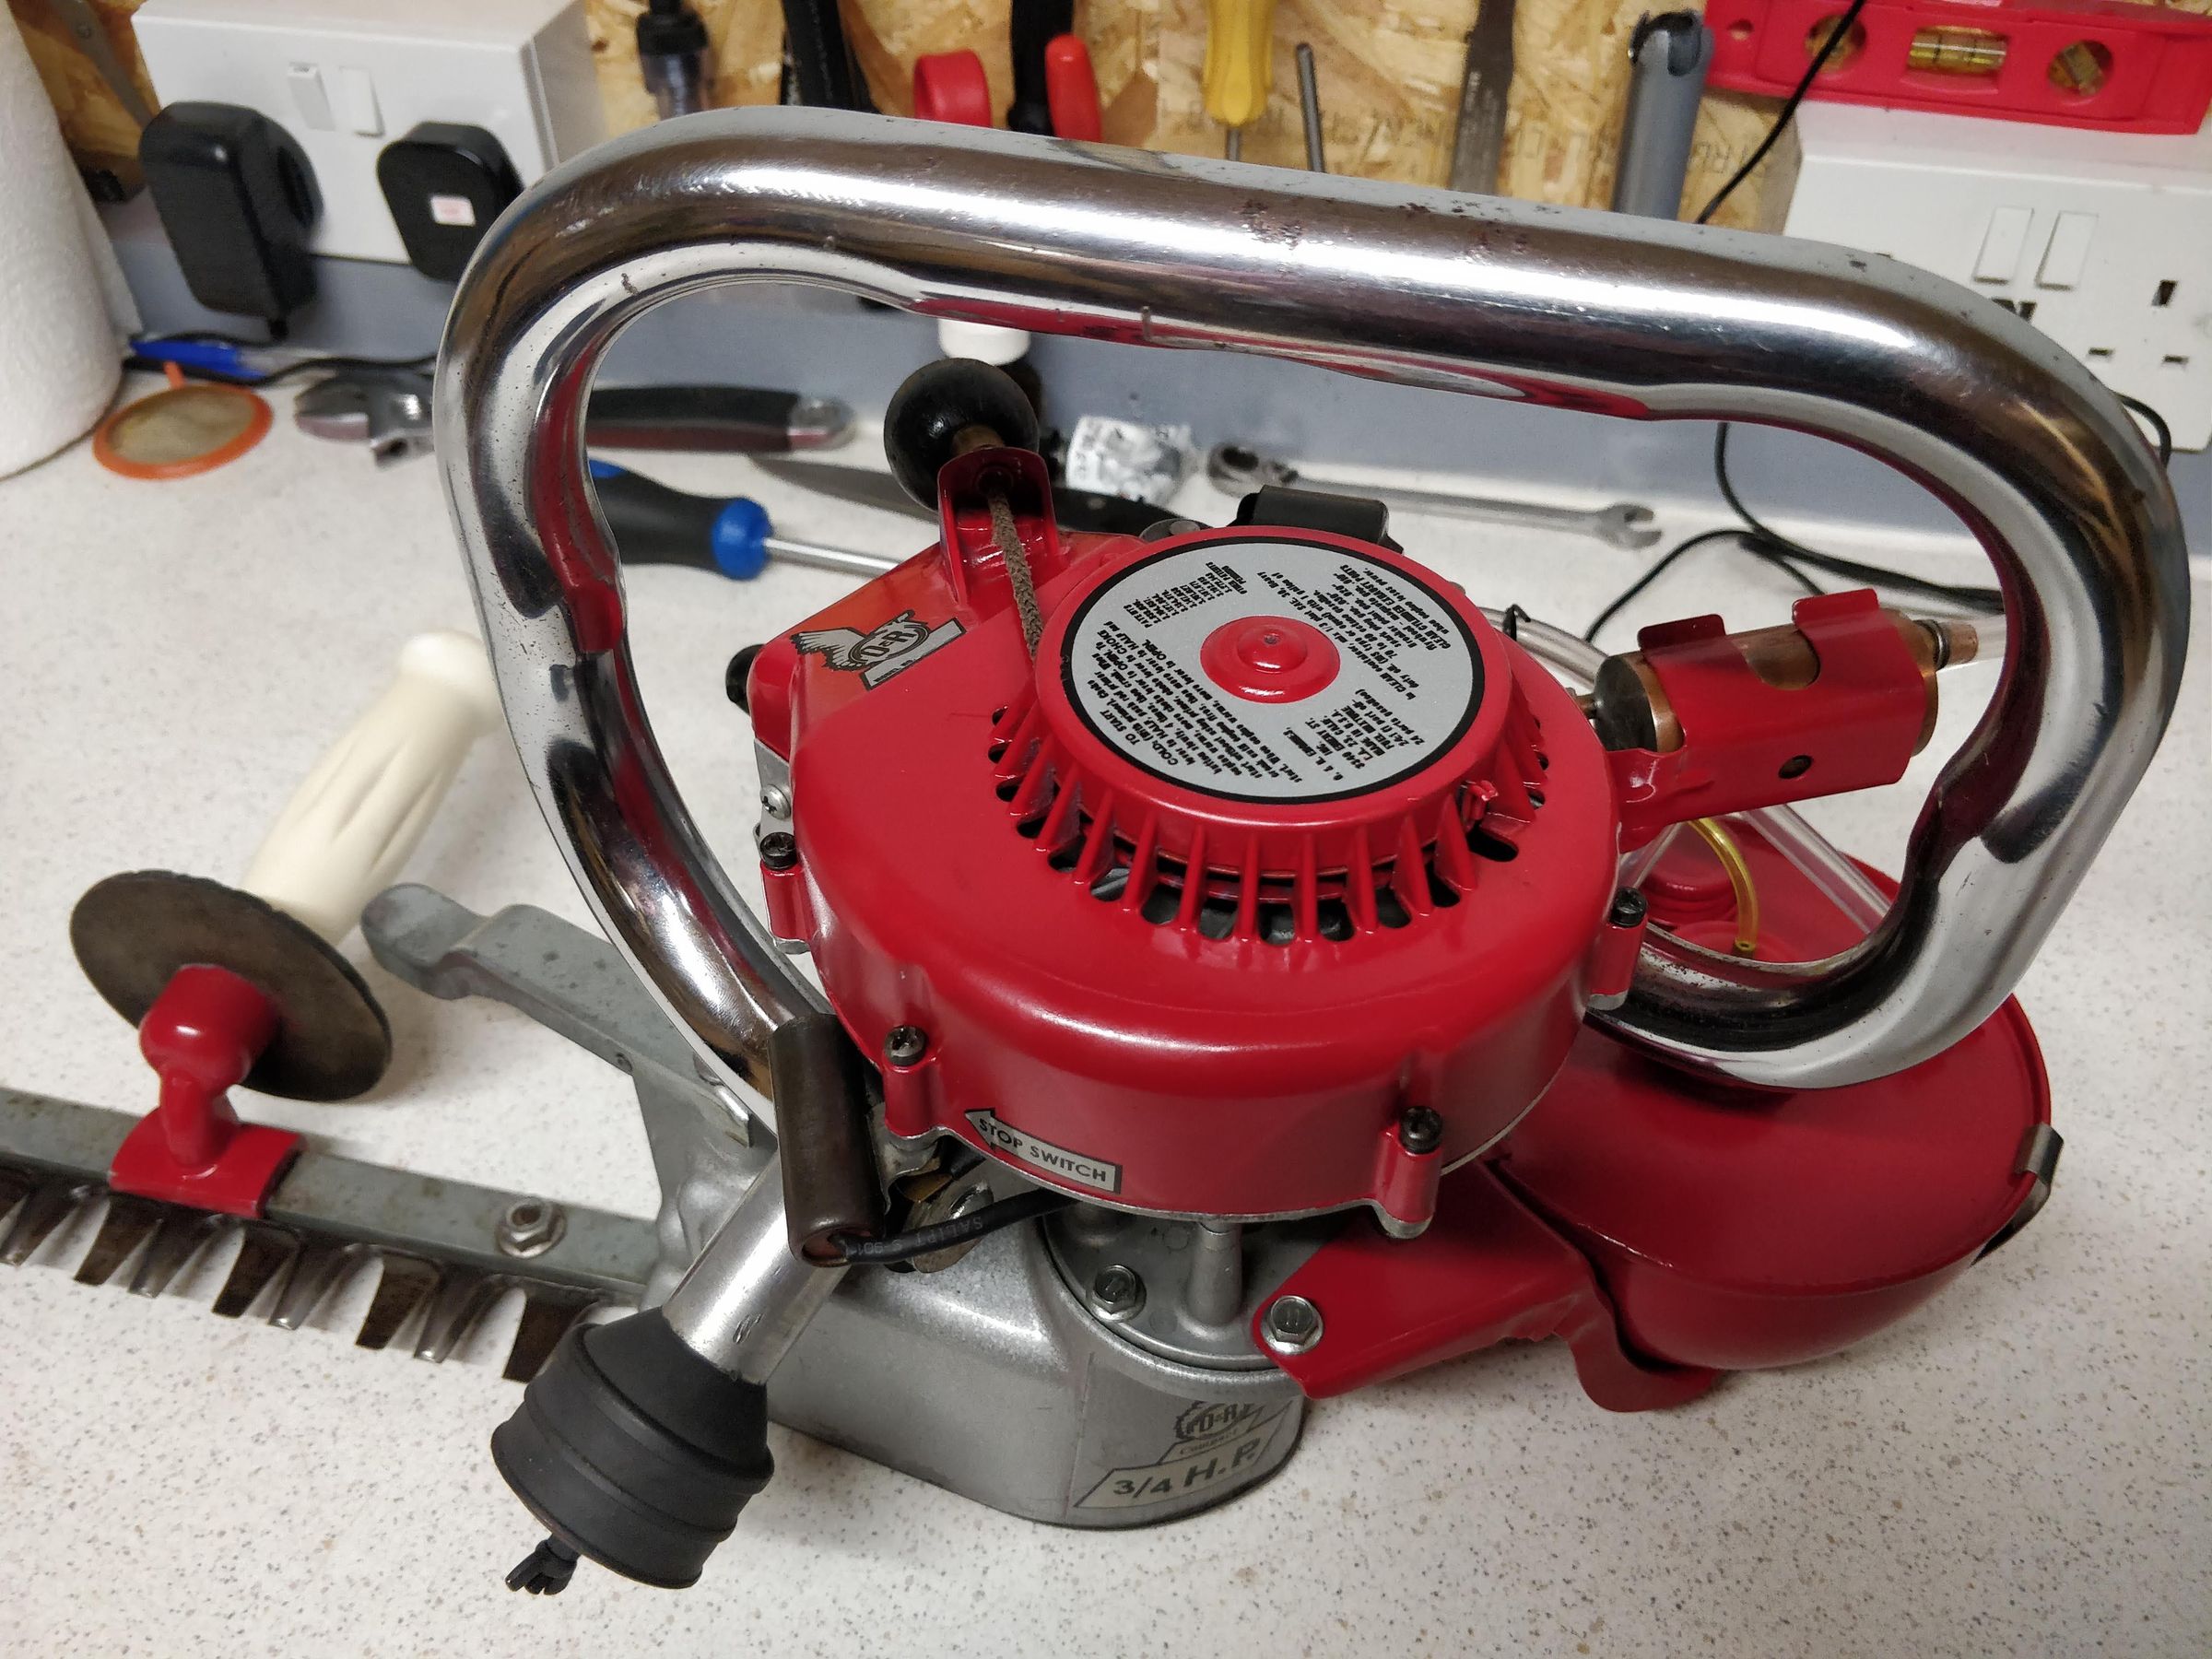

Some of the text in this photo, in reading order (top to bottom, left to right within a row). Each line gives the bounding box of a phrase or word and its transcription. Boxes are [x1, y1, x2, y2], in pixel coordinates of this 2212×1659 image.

[1097, 629, 1127, 654] CHOKE
[1115, 632, 1139, 650] HALF
[1135, 678, 1155, 695] lever
[1100, 710, 1126, 732] START
[1143, 716, 1168, 739] HALF,
[1151, 739, 1178, 765] COLD:
[1175, 747, 1195, 765] lever
[1359, 736, 1385, 756] MADE
[979, 1118, 1107, 1182] STOP SWITCH
[1113, 1477, 1173, 1499] 3/4
